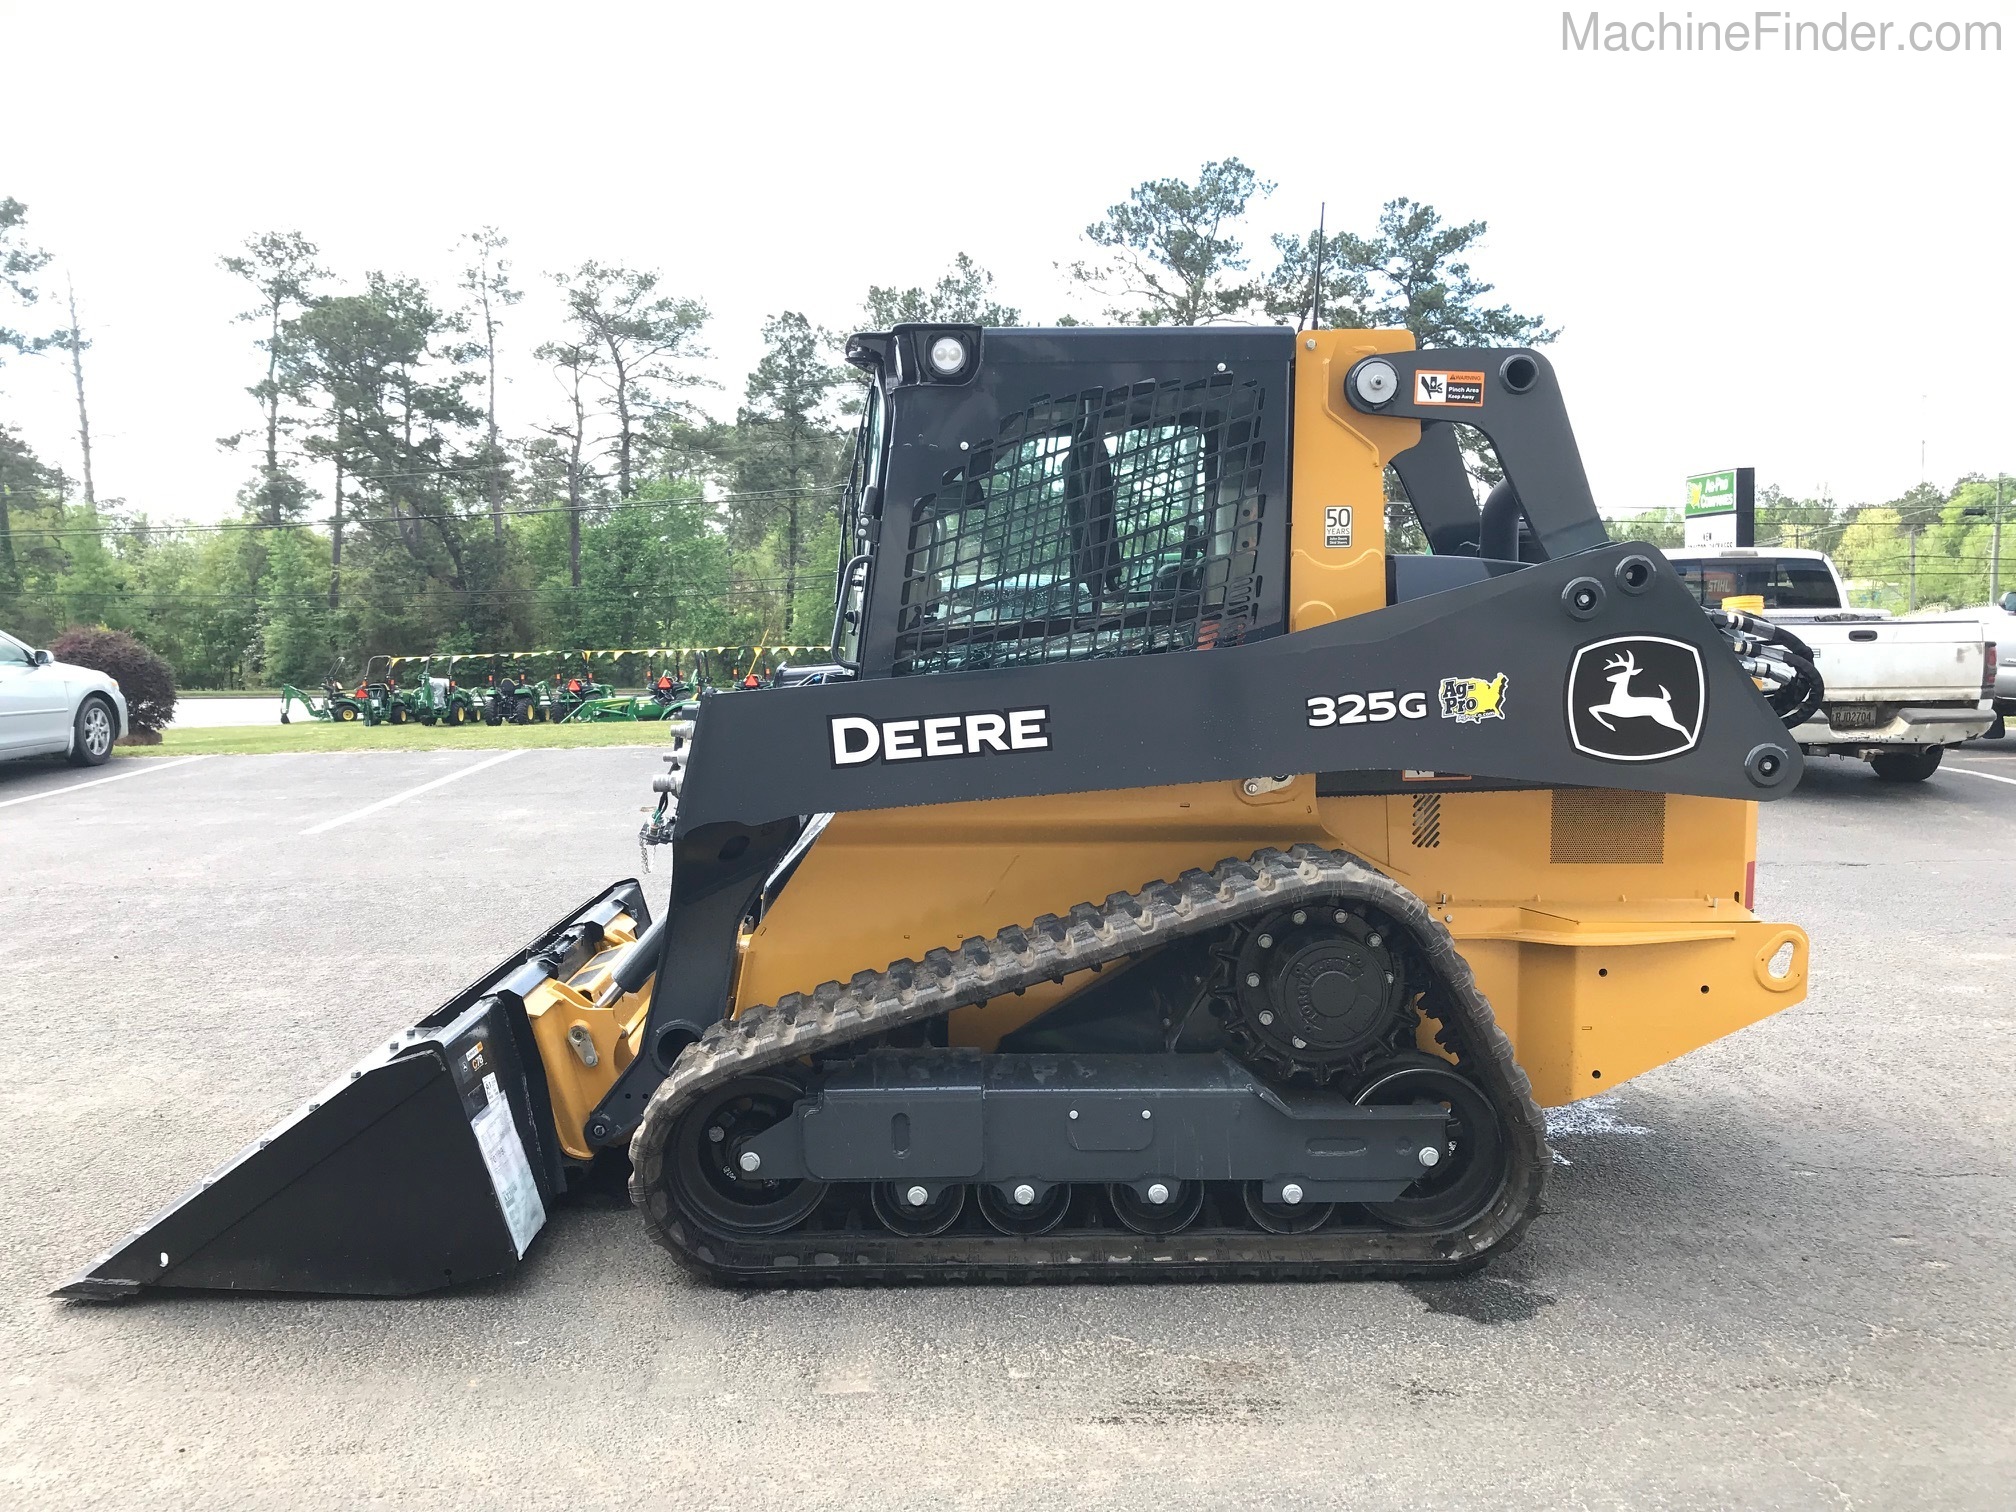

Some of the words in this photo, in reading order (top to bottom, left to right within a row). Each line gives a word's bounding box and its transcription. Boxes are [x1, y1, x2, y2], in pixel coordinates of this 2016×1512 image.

[1327, 508, 1351, 527] 50
[1708, 579, 1731, 592] STIHL
[1443, 681, 1475, 699] Ag-
[1307, 691, 1427, 727] 325G
[1445, 698, 1477, 714] Pro
[831, 709, 1048, 765] DEERE
